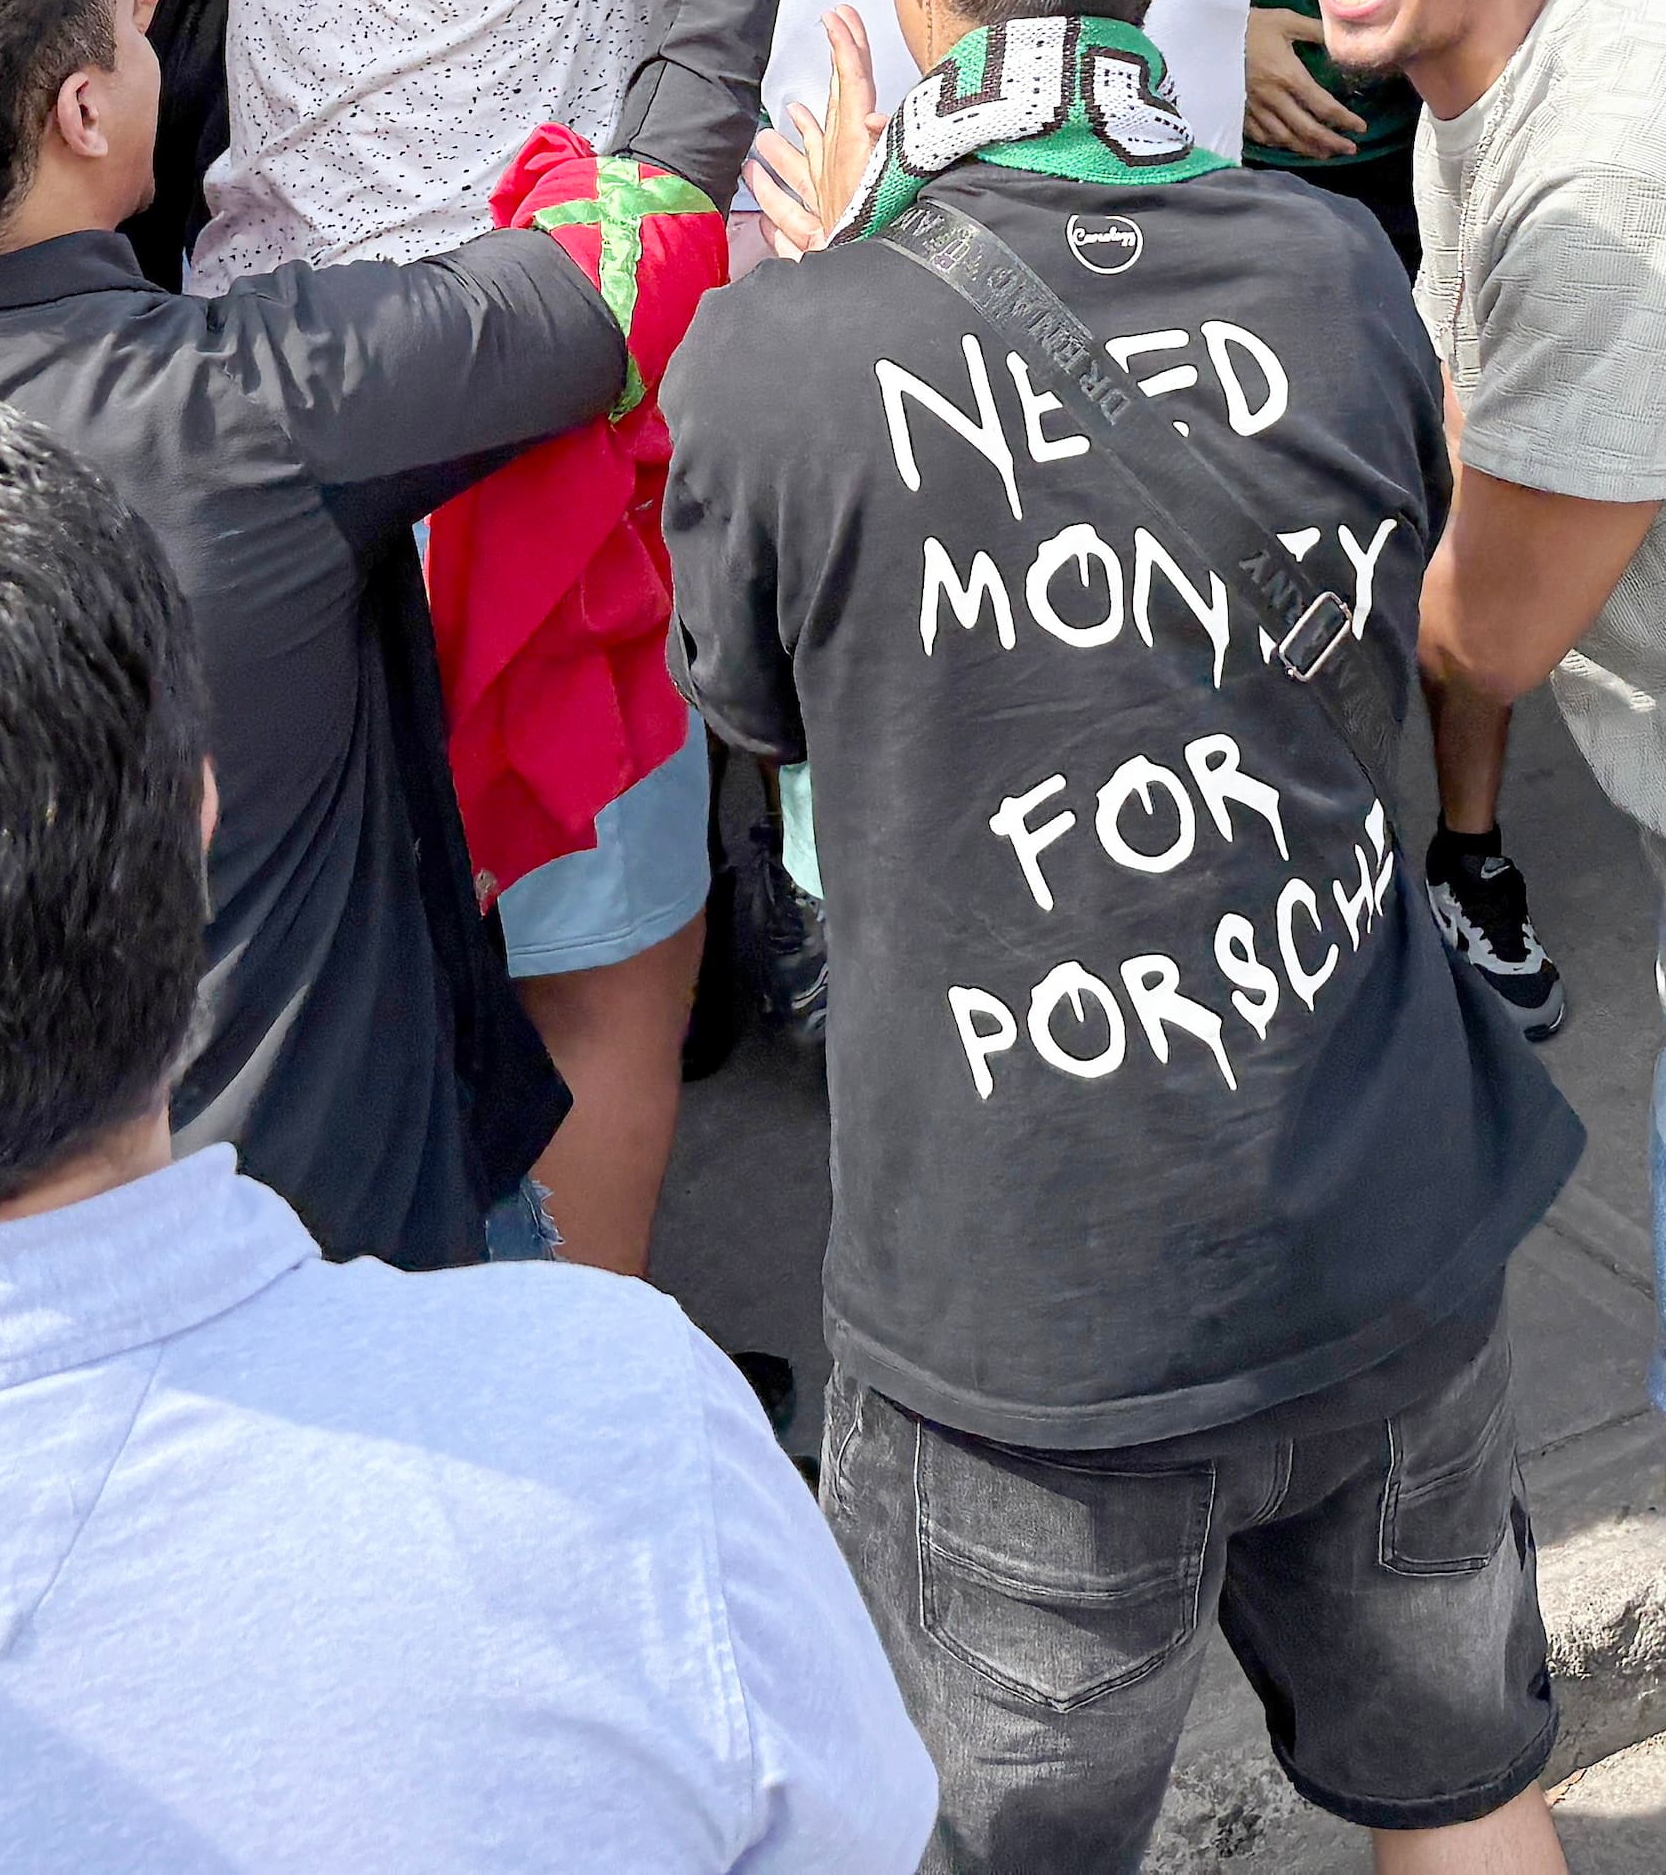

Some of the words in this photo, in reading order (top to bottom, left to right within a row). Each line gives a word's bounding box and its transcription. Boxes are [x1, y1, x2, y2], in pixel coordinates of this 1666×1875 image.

[874, 319, 1289, 521] NEED
[920, 518, 1398, 690] MONY
[988, 732, 1291, 913] FOR
